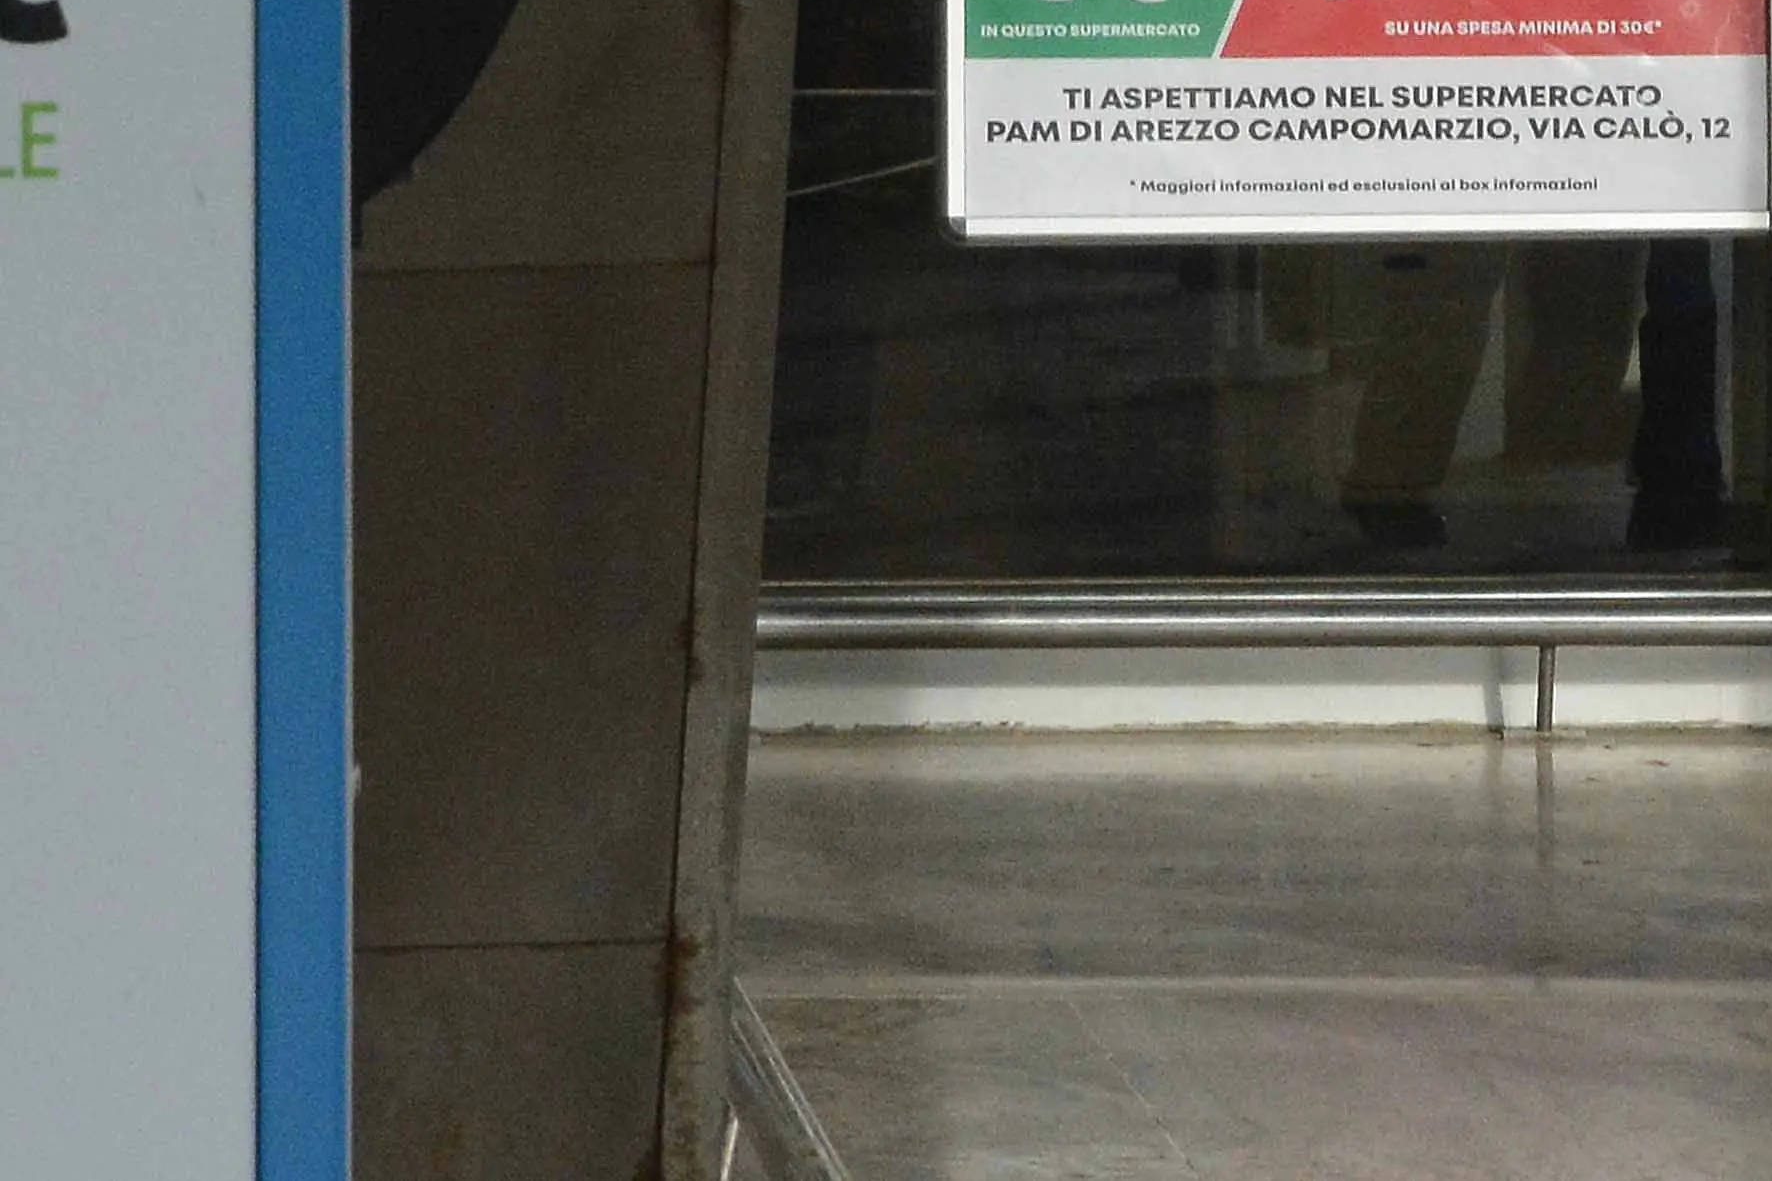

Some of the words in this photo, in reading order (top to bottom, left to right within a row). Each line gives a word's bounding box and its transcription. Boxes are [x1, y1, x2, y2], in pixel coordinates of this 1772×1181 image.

[980, 24, 999, 38] IN
[1000, 23, 1068, 39] QUESTO
[1070, 22, 1201, 38] SUPERMERCATO
[1384, 20, 1410, 36] SU
[1413, 20, 1454, 36] UNA
[1456, 20, 1516, 36] SPESA
[1518, 20, 1594, 36] MINIMA
[1596, 19, 1616, 35] DI
[1062, 87, 1092, 110] TI
[1099, 86, 1316, 110] ASPETTIAMO
[1325, 85, 1385, 109] NEL
[1391, 84, 1662, 109] SUPERMERCATO
[987, 120, 1061, 144] PAM
[1070, 119, 1102, 142] DI
[1110, 118, 1240, 142] AREZZO
[1248, 117, 1520, 145] CAMPOMARZIO,
[1527, 116, 1586, 140] VIA
[1593, 109, 1693, 144] CALÒ,
[1701, 117, 1731, 139] 12
[1140, 178, 1216, 196] Maggiori
[1219, 178, 1324, 193] informazioni
[1327, 178, 1349, 192] ed
[1352, 178, 1437, 192] esclusioni
[1439, 178, 1456, 192] al
[1459, 178, 1490, 192] box
[1493, 177, 1598, 192] informazioni
